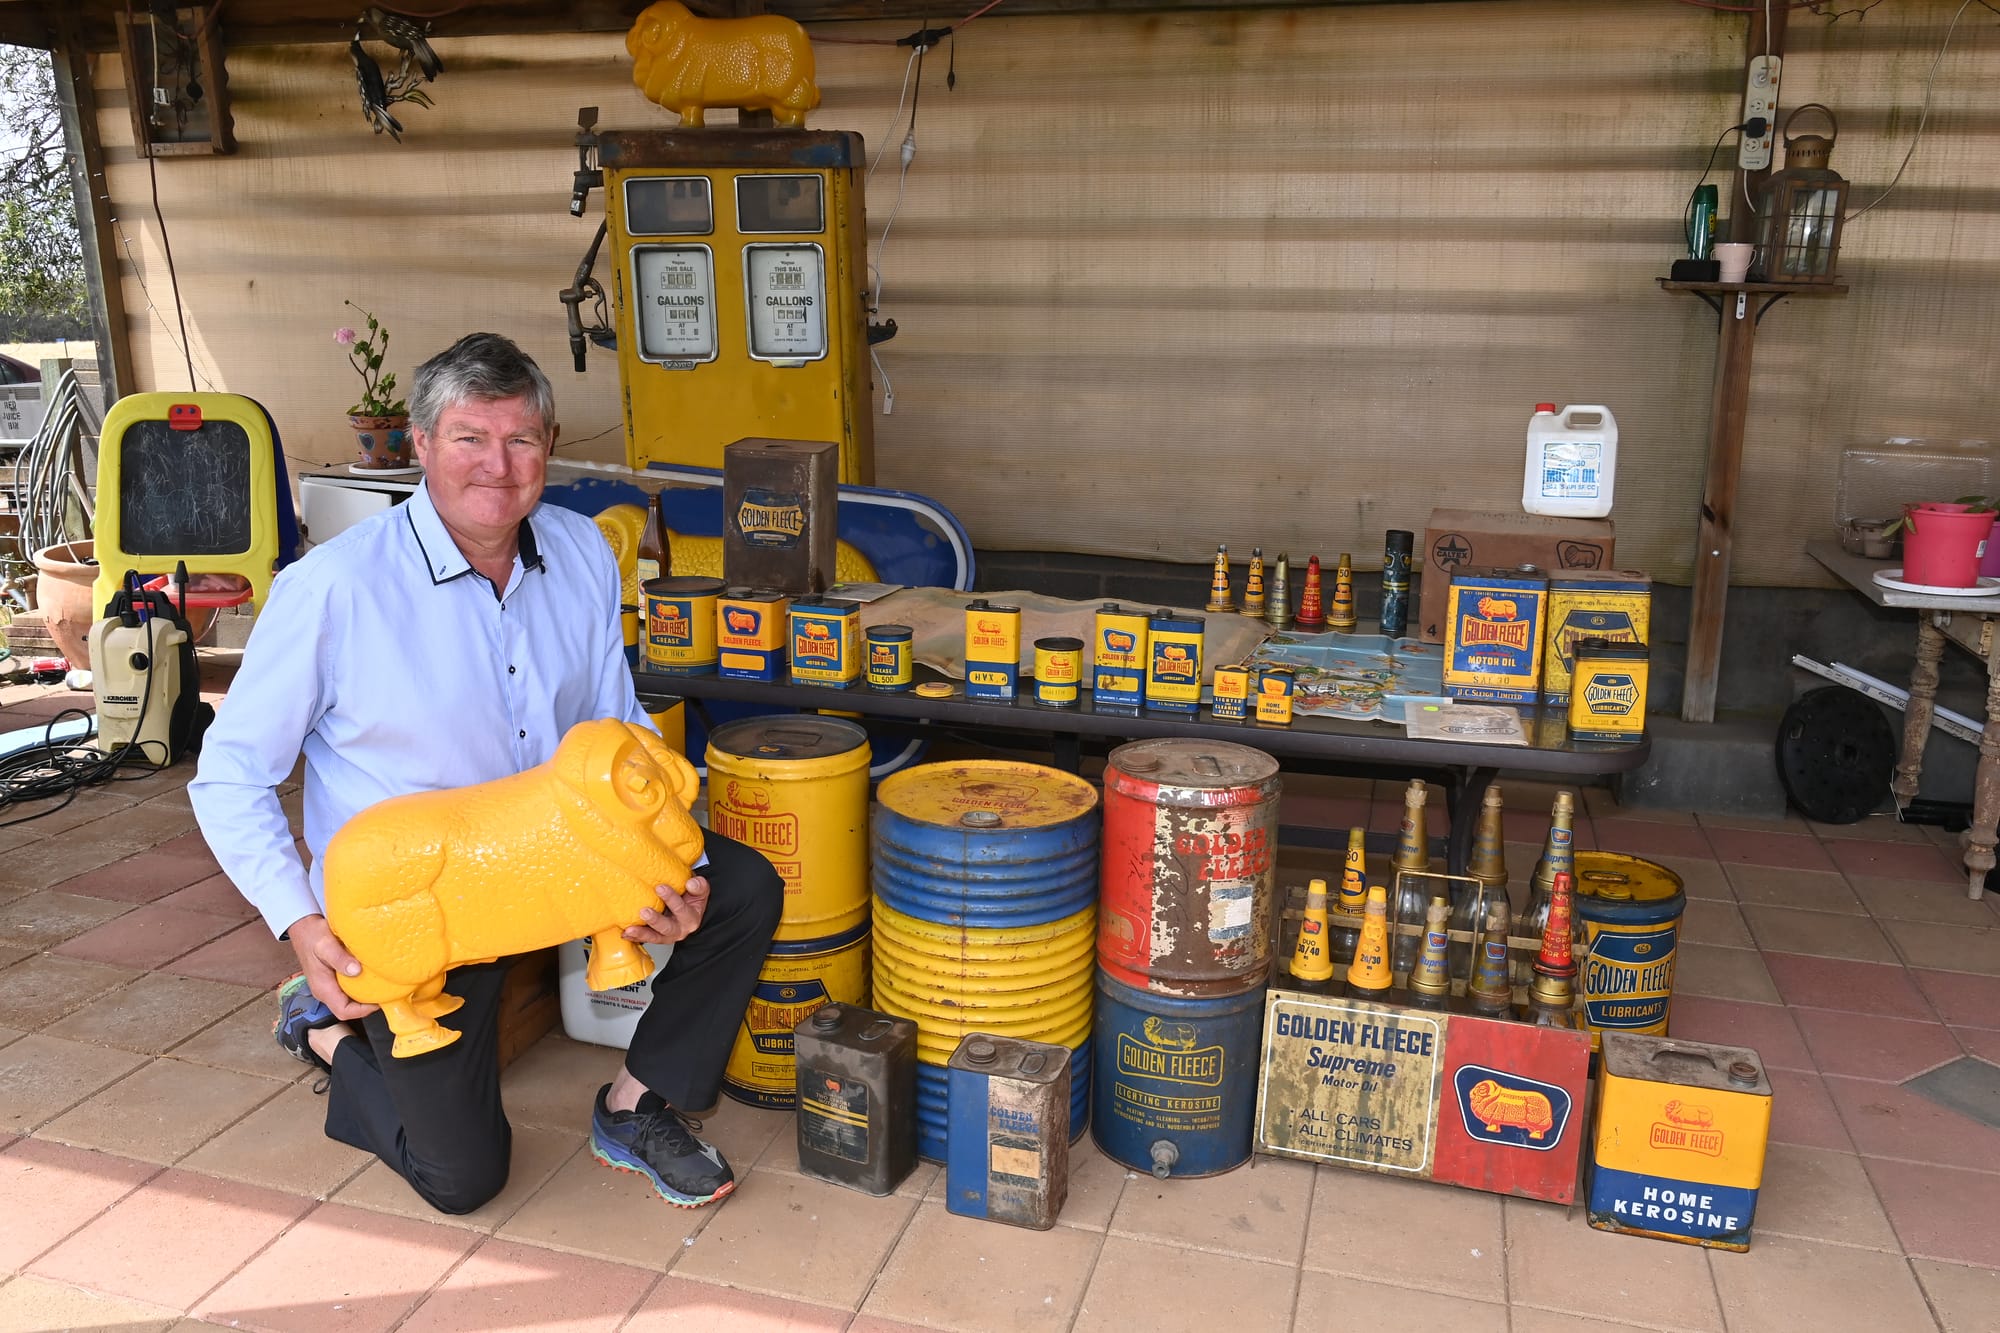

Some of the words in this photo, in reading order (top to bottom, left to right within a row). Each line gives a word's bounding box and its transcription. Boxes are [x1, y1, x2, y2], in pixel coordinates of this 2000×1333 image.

[657, 295, 705, 306] GALLONS
[766, 296, 813, 306] GALLONS
[741, 507, 770, 528] GOLDEN
[772, 510, 799, 530] FLEECE
[1436, 551, 1468, 559] CALTEX
[1339, 569, 1350, 577] 50
[651, 617, 668, 633] GOLDEN
[669, 619, 686, 635] FLEECE
[1427, 624, 1437, 637] 4
[1466, 618, 1498, 642] GOLDEN
[1500, 624, 1526, 646] FLEECE
[656, 636, 680, 644] GREASE
[723, 636, 743, 645] GOLDEN
[743, 638, 761, 647] FLEECE
[974, 636, 990, 645] GOLDEN
[990, 637, 1006, 646] FLEECE
[798, 638, 819, 654] GOLDEN
[819, 641, 835, 658] FLEECE
[1158, 659, 1176, 672] GOLDEN
[1177, 661, 1191, 674] FLEECE
[1468, 656, 1500, 665] MOTOR
[1502, 658, 1516, 667] OIL
[1047, 668, 1060, 676] GOLDEN
[881, 676, 894, 684] 500
[1472, 690, 1494, 698] SLEIGH
[1497, 692, 1523, 700] LIMITED
[1588, 686, 1611, 701] GOLDEN
[1613, 687, 1633, 703] FLEECE
[952, 798, 992, 806] GOLDEN
[715, 811, 747, 841] GOLDEN
[753, 822, 793, 846] FLEECE
[1175, 827, 1266, 856] GOLDEN
[1346, 850, 1358, 862] 50
[1302, 938, 1316, 946] DUO
[1586, 960, 1638, 994] GOLDEN
[591, 999, 616, 1007] CONTENTS
[621, 998, 647, 1006] PETROLEUM
[750, 1000, 791, 1030] GOLDEN
[1601, 1002, 1663, 1018] LUBRICANTS
[1276, 1013, 1356, 1045] GOLDEN
[1360, 1023, 1433, 1057] FLEECE
[1123, 1044, 1166, 1074] GOLDEN
[1171, 1055, 1218, 1077] FLEECE
[1307, 1046, 1397, 1078] Supreme
[1321, 1074, 1360, 1090] Motor
[1361, 1080, 1379, 1092] Oil
[1118, 1086, 1160, 1107] LIGHTING
[1167, 1098, 1218, 1110] KEROSINE
[990, 1107, 1033, 1122] GOLDEN
[1126, 1107, 1145, 1118] HEATING
[1156, 1115, 1180, 1123] CLEANING
[1300, 1108, 1329, 1122] ALL
[1336, 1113, 1381, 1130] CARS
[999, 1118, 1040, 1133] FLEECE
[1197, 1122, 1220, 1130] PURPOSES
[1299, 1123, 1328, 1138] ALL
[1335, 1129, 1413, 1151] CLIMATES
[1654, 1128, 1687, 1146] GOLDEN
[1690, 1133, 1719, 1151] FLEECE
[1643, 1186, 1713, 1210] HOME
[1613, 1199, 1739, 1231] KEROSINE
